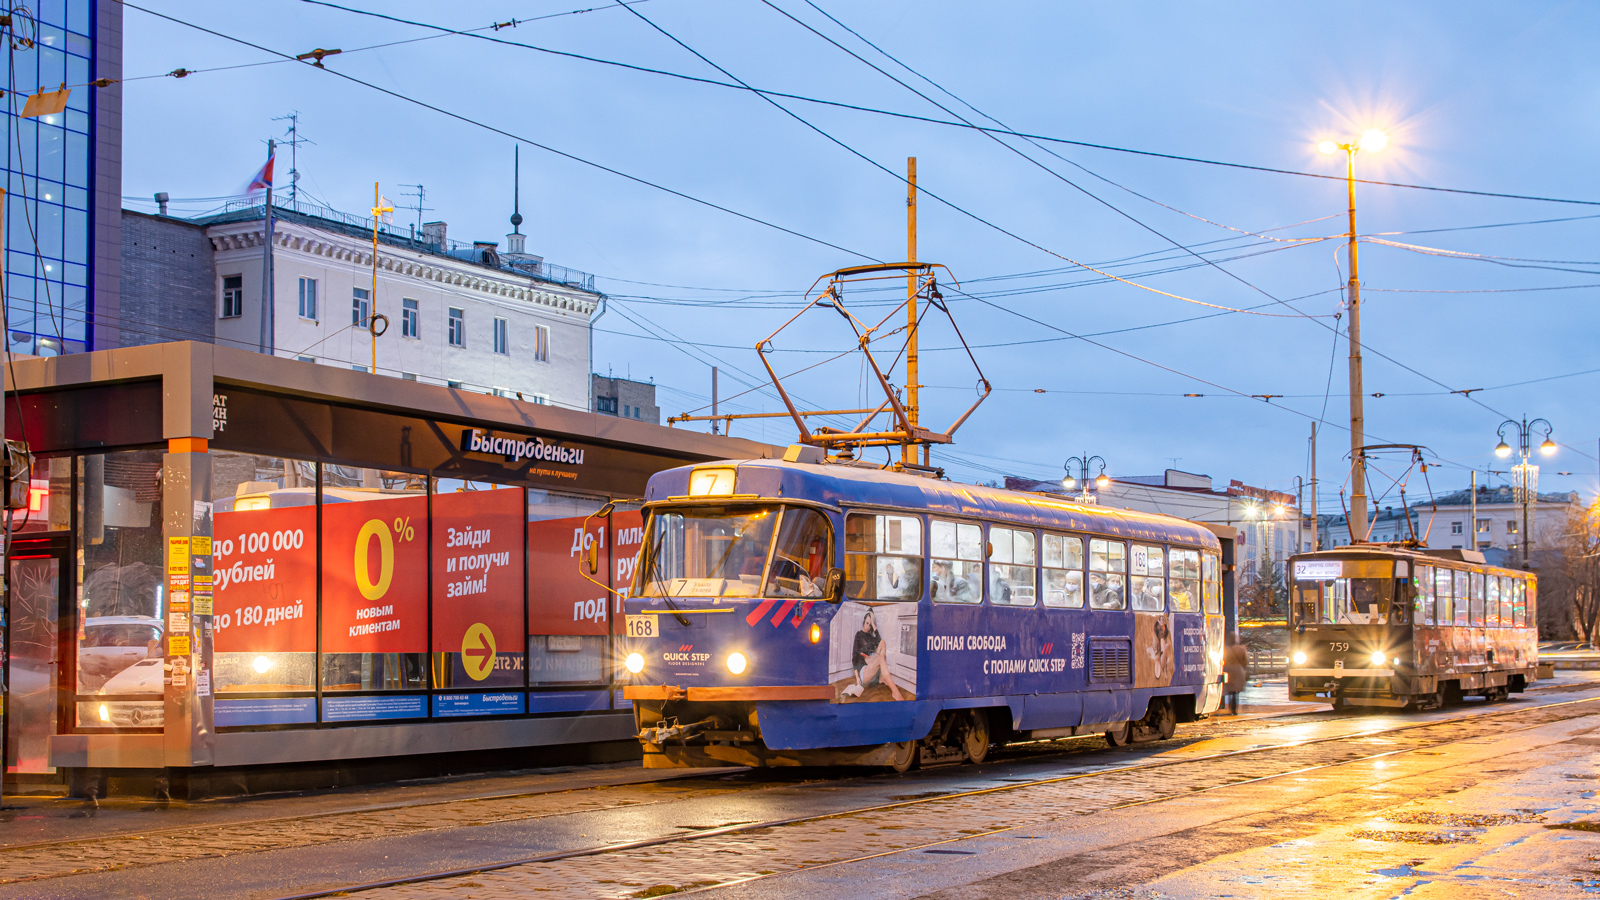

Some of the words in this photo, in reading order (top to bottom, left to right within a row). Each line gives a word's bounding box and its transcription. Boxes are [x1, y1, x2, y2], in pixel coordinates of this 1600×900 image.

[213, 394, 227, 406] АТ
[470, 429, 584, 465] Быстроденьги
[706, 474, 718, 495] 7
[213, 539, 234, 560] до
[238, 531, 270, 554] 100
[272, 528, 304, 551] 000
[446, 526, 490, 549] Зайди
[570, 527, 594, 558] До
[597, 526, 604, 549] 1
[446, 558, 456, 573] и
[458, 551, 509, 573] получи
[1296, 565, 1306, 575] 32
[446, 574, 487, 598] займ!
[676, 579, 688, 596] 7
[235, 605, 263, 627] 180
[264, 599, 303, 627] дней
[356, 604, 393, 620] новым
[573, 597, 606, 624] под
[349, 619, 400, 637] клиентам
[629, 620, 652, 636] 168
[926, 636, 964, 650] ПОЛНАЯ
[967, 636, 1007, 652] СВОБОДА
[1330, 642, 1349, 652] 759
[983, 660, 989, 675] С
[990, 659, 1027, 674] ПОЛАМИ
[482, 694, 518, 703] Быстроденьги
